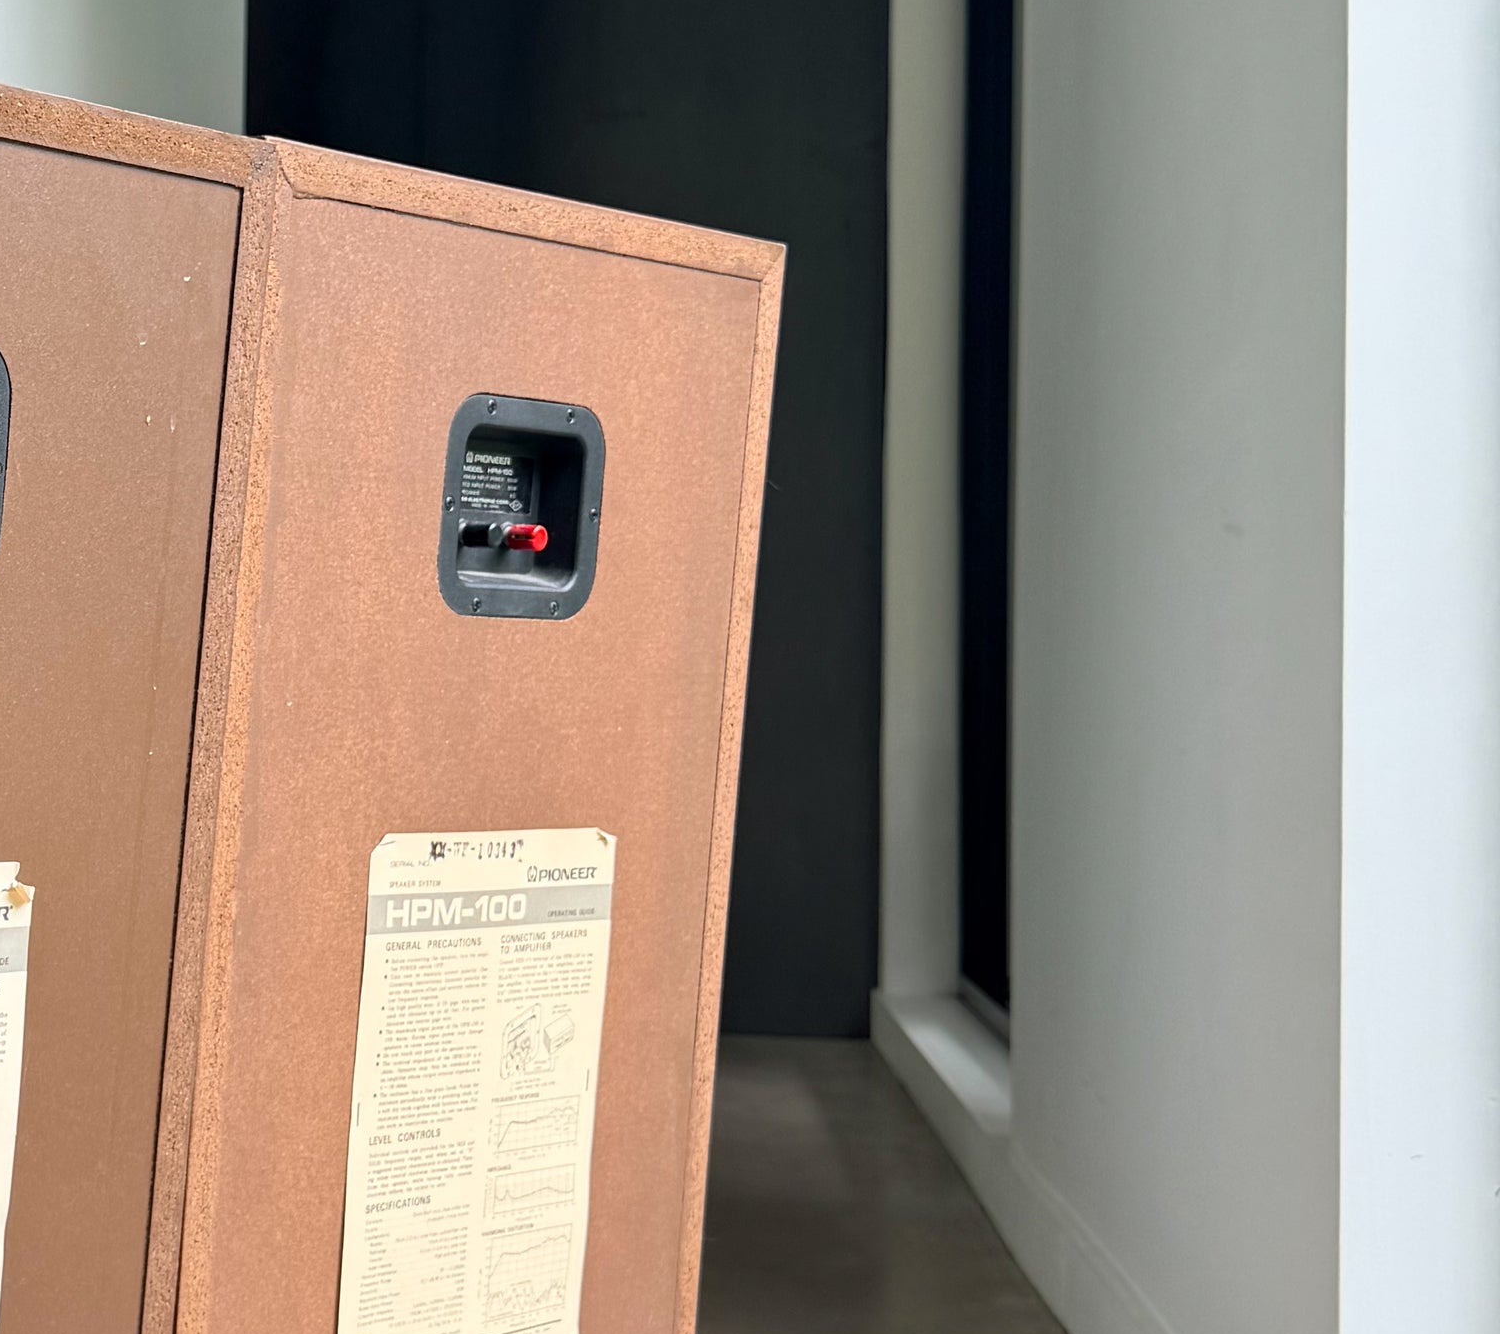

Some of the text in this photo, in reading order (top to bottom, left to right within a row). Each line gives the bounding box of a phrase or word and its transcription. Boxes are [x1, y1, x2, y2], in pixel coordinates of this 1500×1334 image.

[474, 454, 511, 465] PIONEER
[538, 866, 595, 881] PIONEER
[385, 893, 526, 928] HPM-100
[500, 928, 587, 943] CONNECTING SPEAKERS
[385, 936, 481, 951] GENERAL PRECAUTIONS
[500, 942, 551, 954] TO AMPLIFIER
[368, 1127, 440, 1146] LEVEL CONTROLS
[365, 1194, 430, 1214] SPECIFICATIONS
